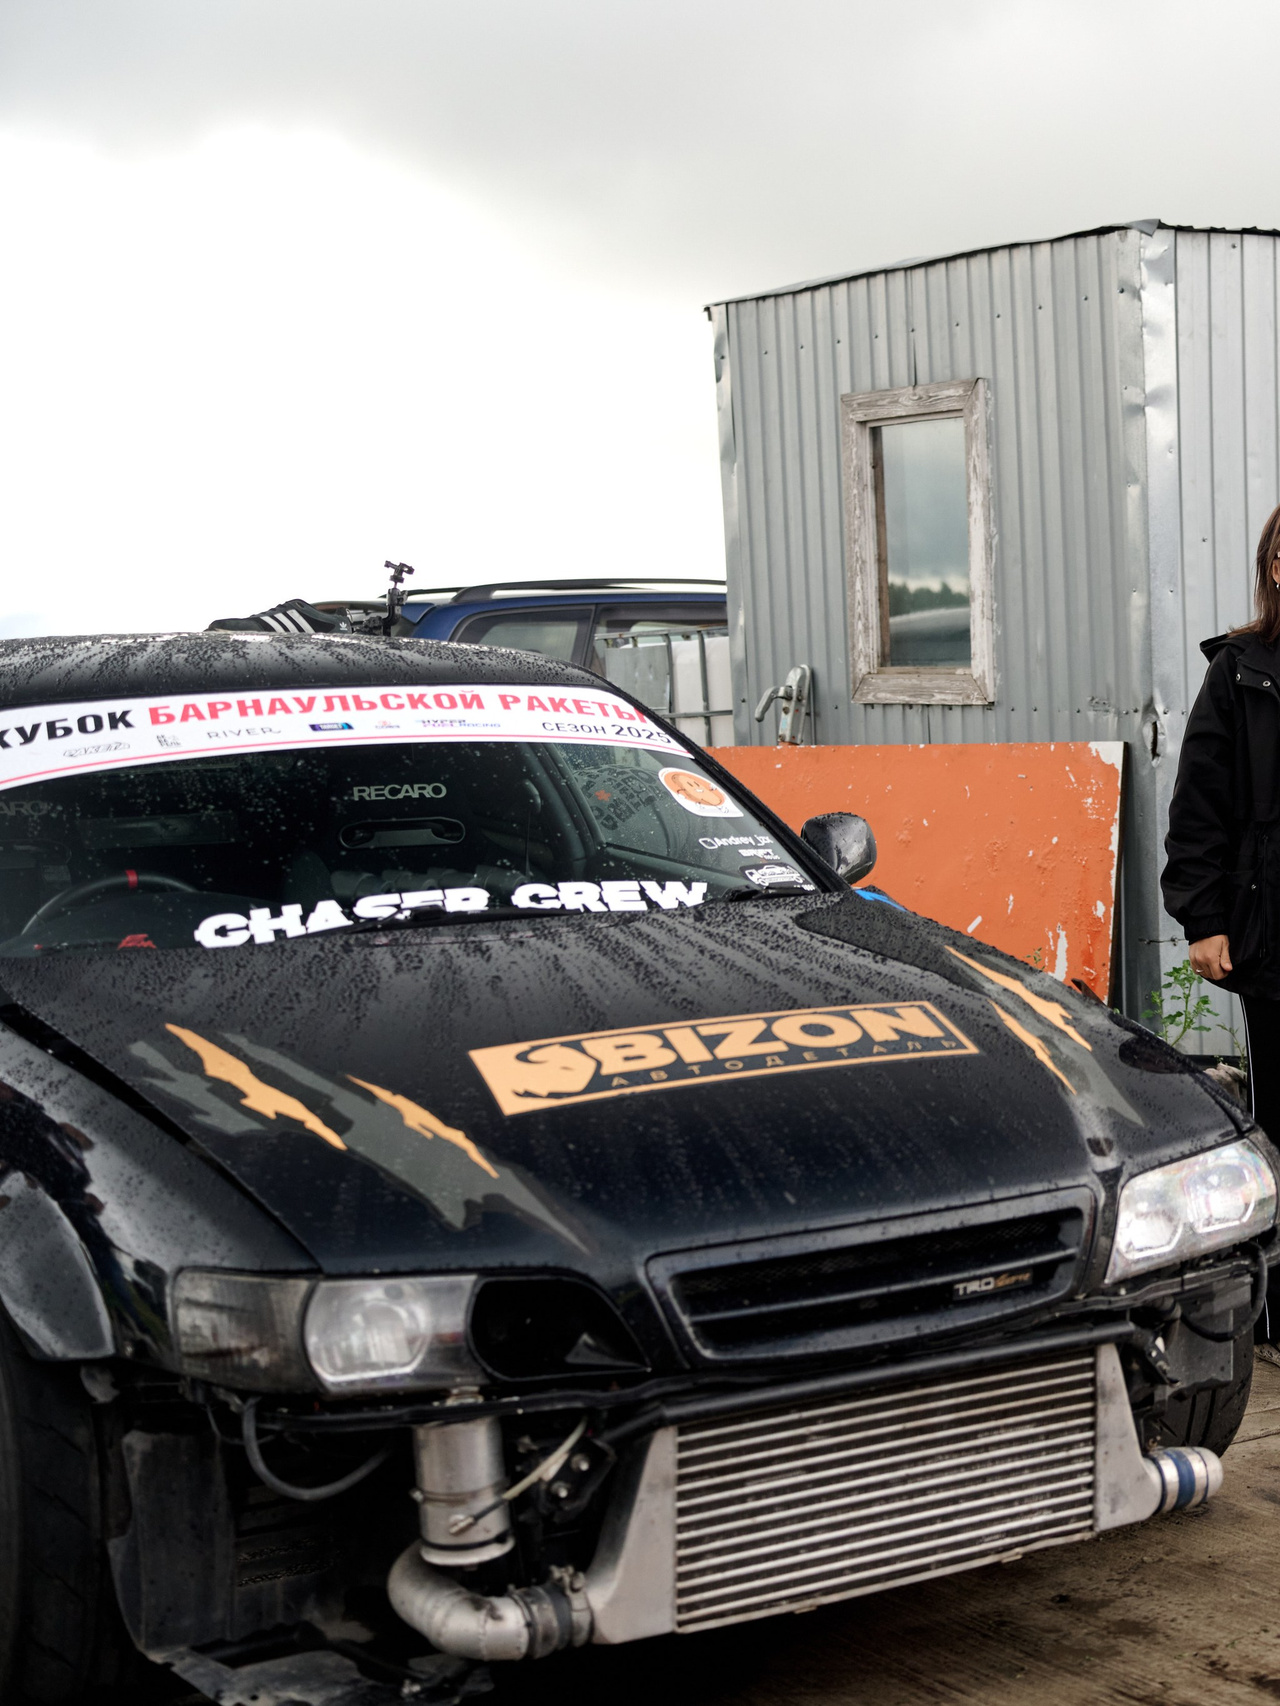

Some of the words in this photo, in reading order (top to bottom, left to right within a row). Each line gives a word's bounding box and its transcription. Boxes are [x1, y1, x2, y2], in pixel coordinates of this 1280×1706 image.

[148, 689, 485, 727] БАРНАУЛЬСКОЙ
[501, 693, 647, 724] РАКЕТЫ
[207, 726, 282, 740] RIVER
[542, 721, 607, 736] СЕЗОН
[611, 723, 672, 744] 2025
[353, 783, 447, 801] RECARO
[511, 880, 708, 912] CREW
[581, 1006, 945, 1076] BIZON
[612, 1039, 958, 1088] АВТОДЕТАЛЬ
